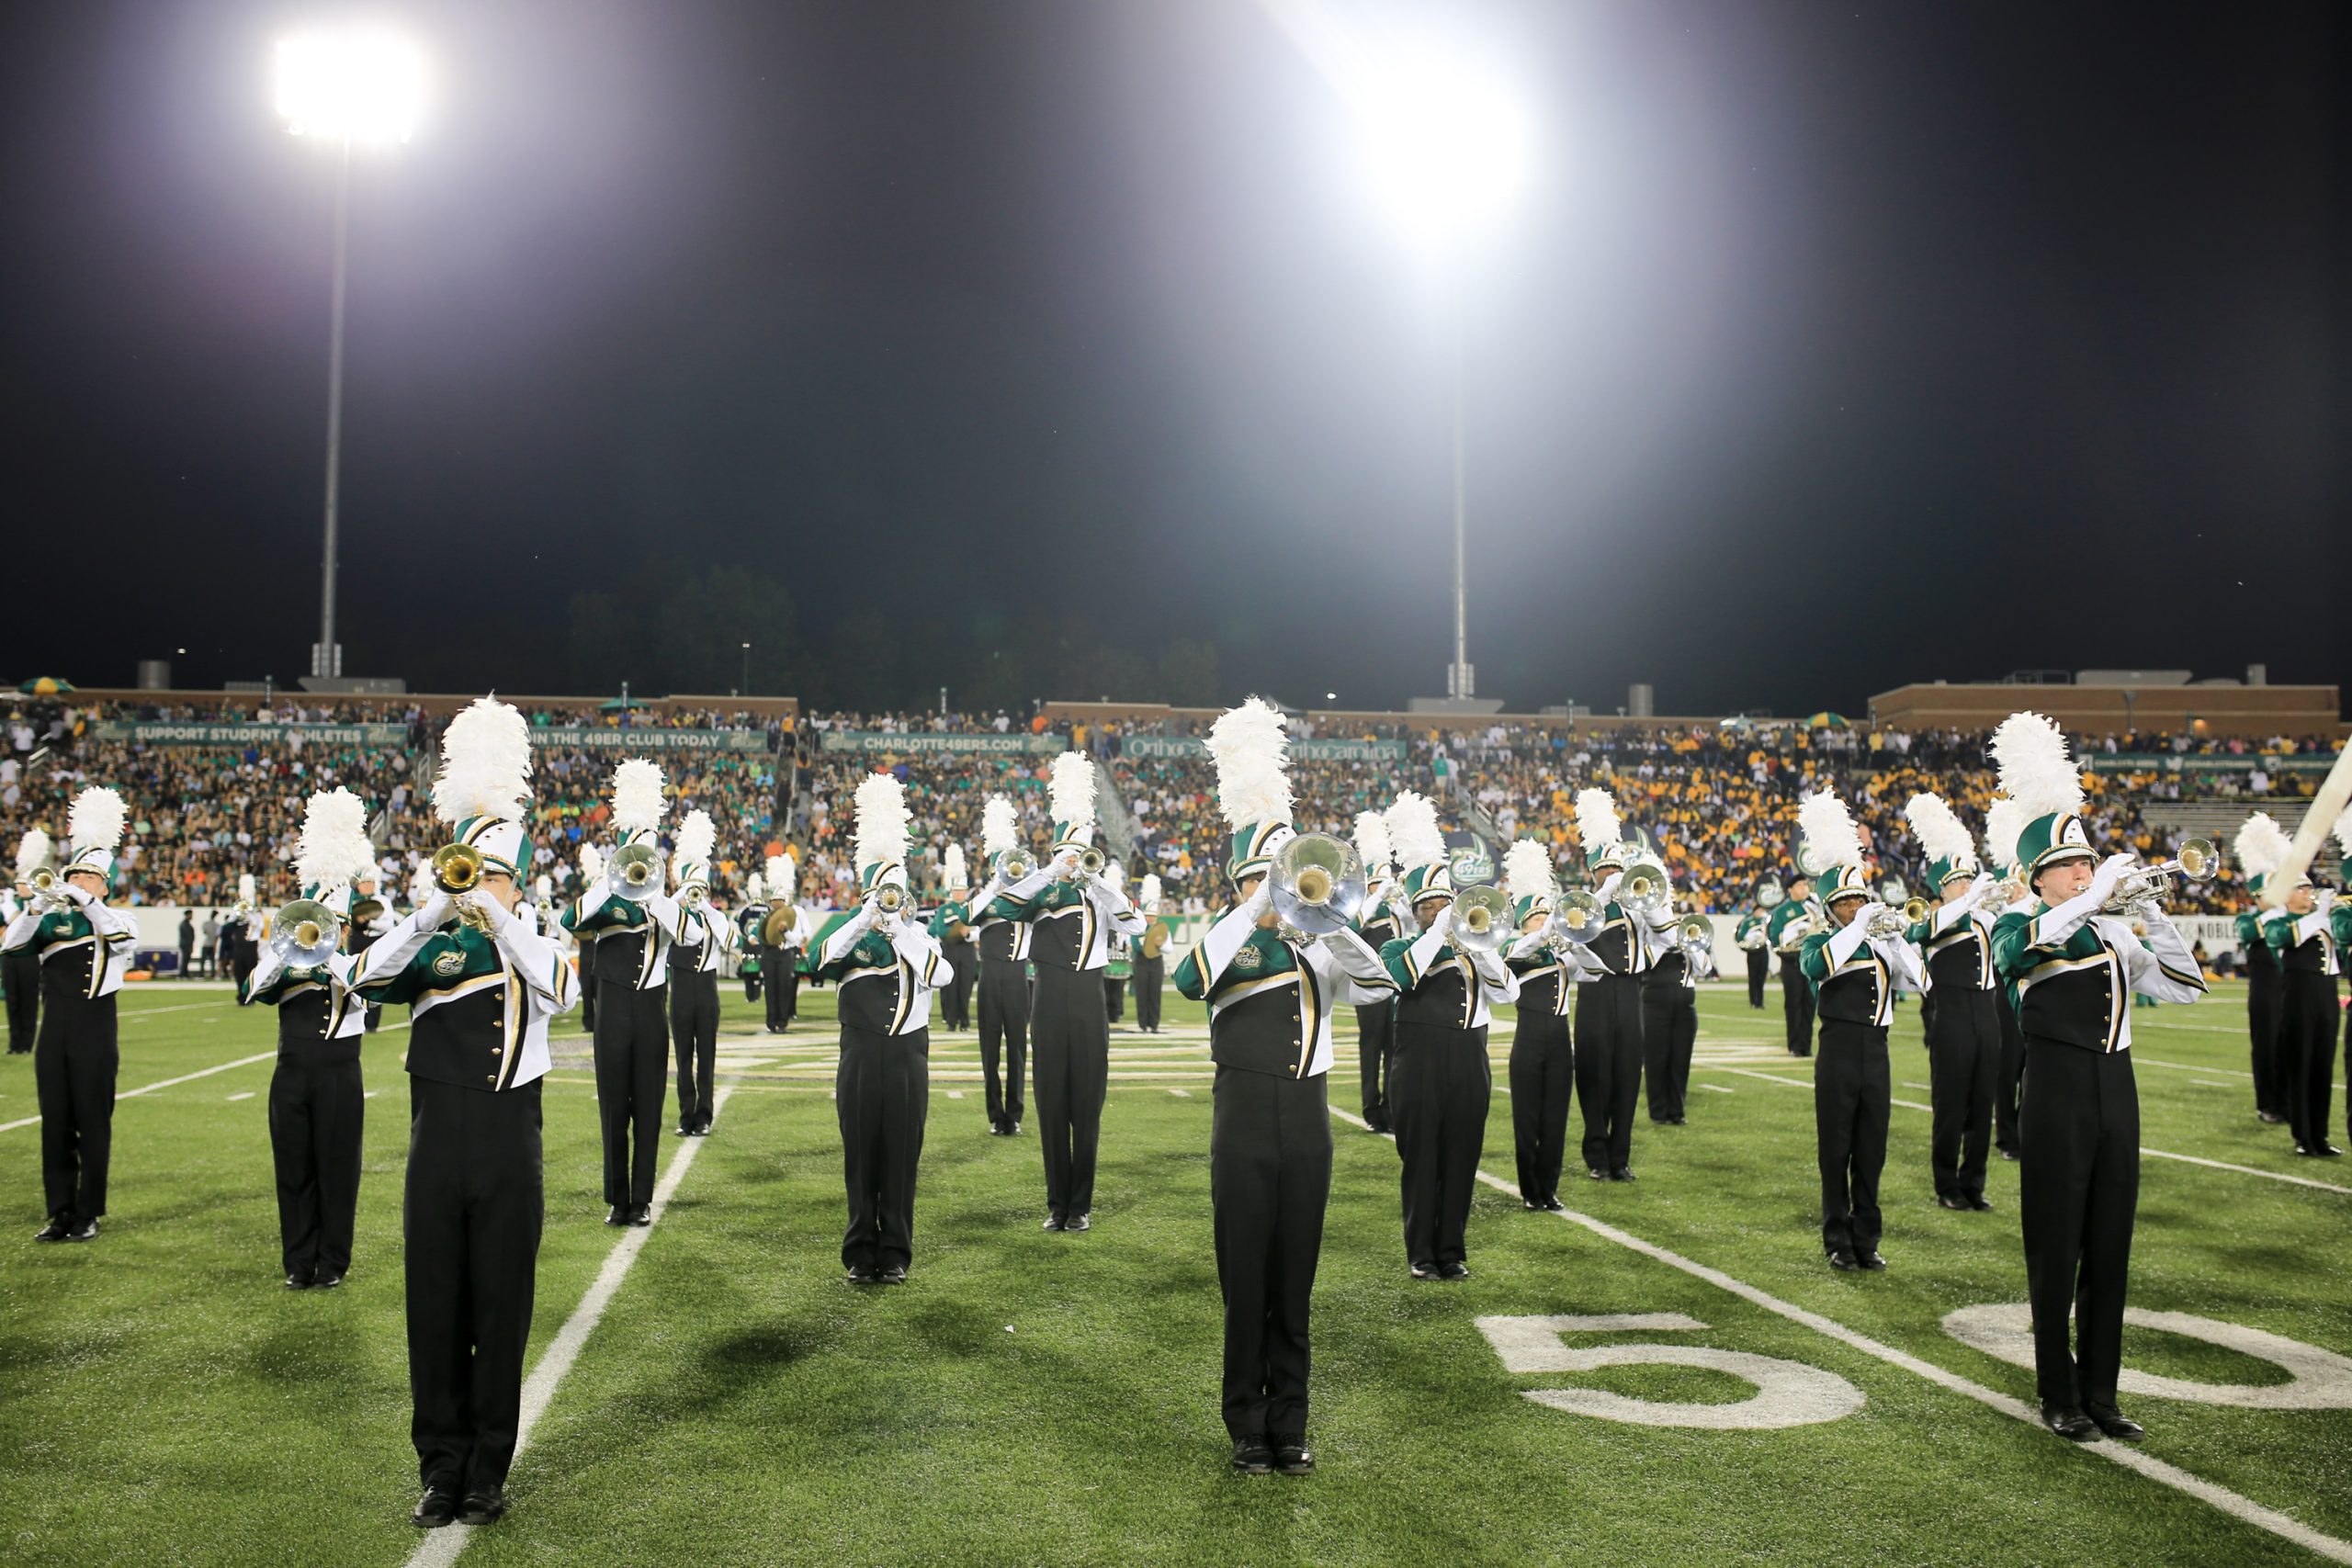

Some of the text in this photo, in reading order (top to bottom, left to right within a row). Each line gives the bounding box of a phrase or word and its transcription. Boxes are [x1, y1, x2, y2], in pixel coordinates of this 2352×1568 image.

[135, 727, 206, 740] SUPPORT
[209, 728, 281, 742] STUDENT
[285, 728, 363, 743] AHLETES
[552, 732, 581, 745] THE
[583, 732, 622, 746] 49ER
[626, 733, 664, 746] CLUB
[668, 734, 719, 747] TODAY
[862, 737, 1023, 750] CHARLOTTE49ERS.COM
